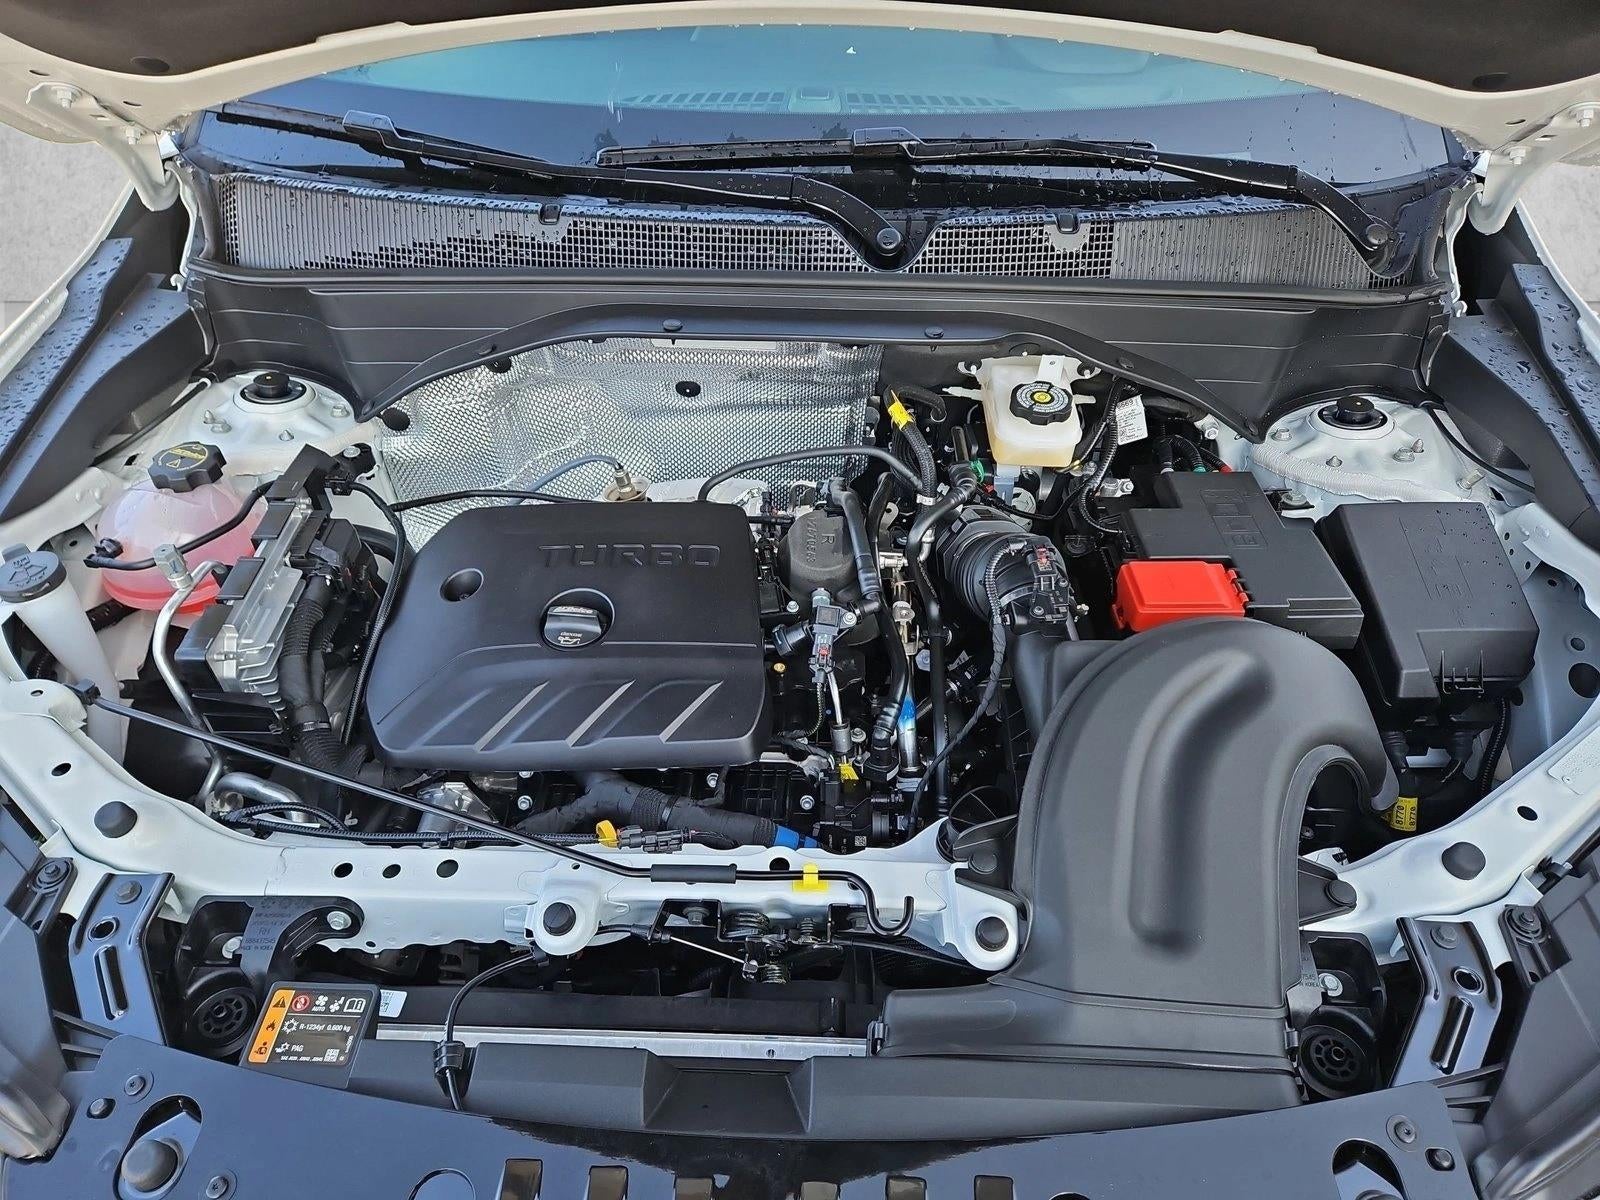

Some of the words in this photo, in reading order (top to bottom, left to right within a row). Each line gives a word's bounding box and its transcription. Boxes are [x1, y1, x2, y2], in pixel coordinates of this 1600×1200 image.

[538, 543, 721, 569] TURBO
[299, 1023, 325, 1031] R-1234yf
[343, 1025, 351, 1033] kg
